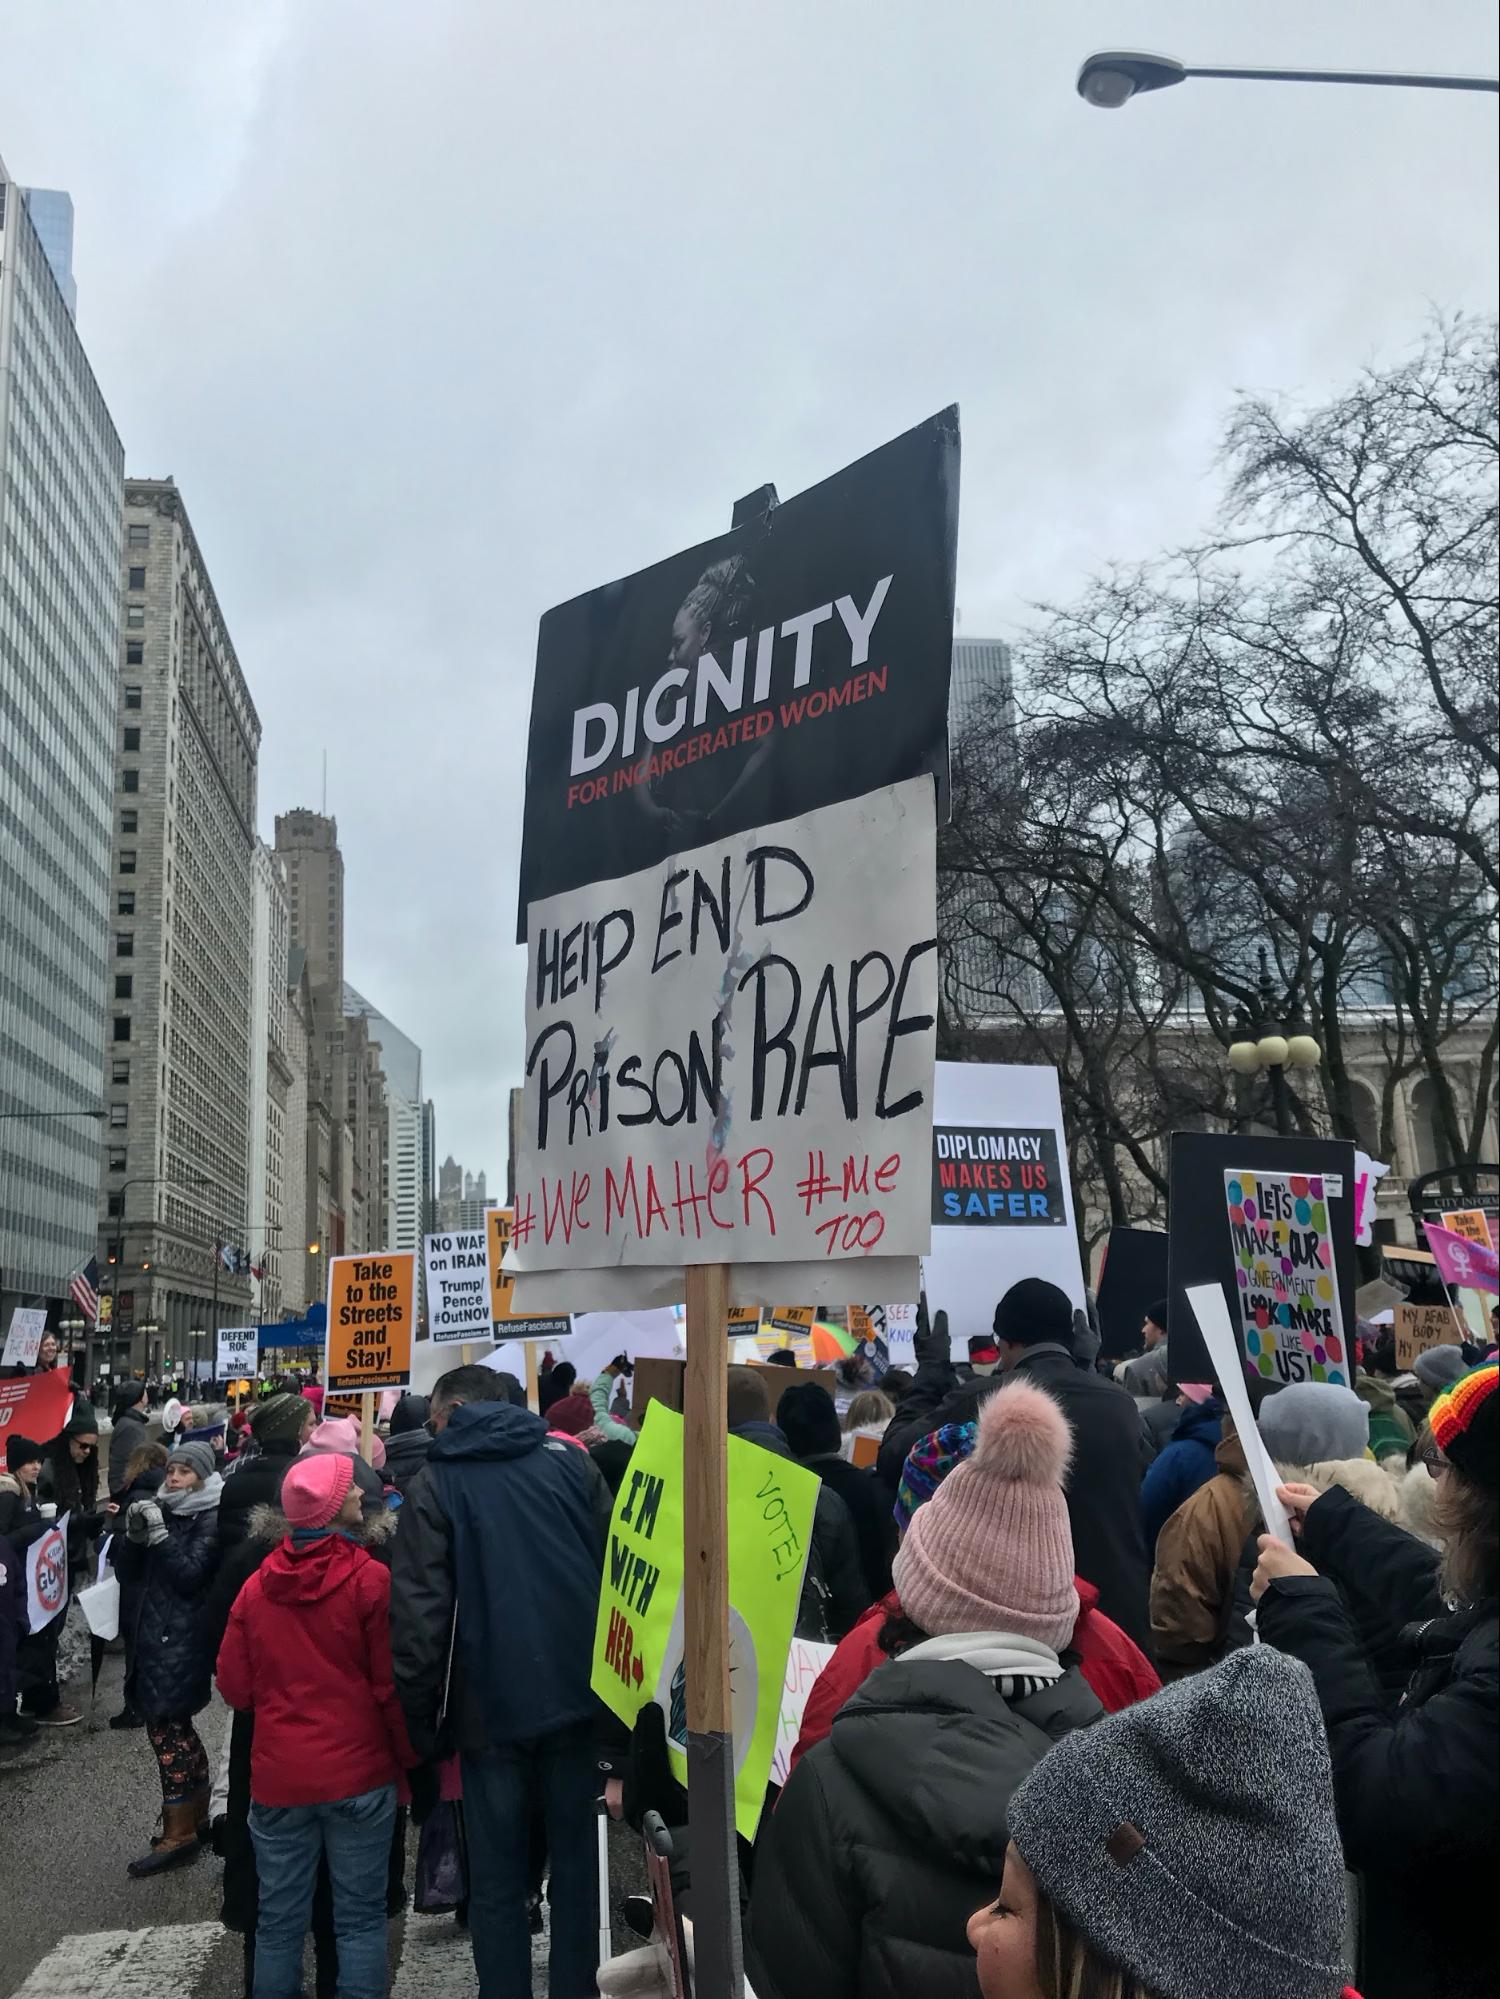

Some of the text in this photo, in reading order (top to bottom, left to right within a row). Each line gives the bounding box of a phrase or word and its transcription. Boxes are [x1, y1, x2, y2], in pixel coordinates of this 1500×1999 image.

[569, 574, 894, 777] DIGNITY
[567, 666, 888, 809] FOR INCARCERATED WOMEN
[651, 845, 815, 974] END
[738, 937, 937, 1121] RAPE
[936, 1134, 1041, 1160] DIPLOMACY
[796, 1150, 901, 1216] #Me
[940, 1163, 1048, 1190] MAKES US
[943, 1192, 1050, 1217] SAFER
[1434, 1198, 1458, 1208] CITY
[1454, 1215, 1475, 1226] Take
[815, 1210, 885, 1255] TOO
[430, 1238, 453, 1253] NO
[1232, 1223, 1325, 1270] MAKE OUR
[353, 1261, 393, 1281] Take
[430, 1253, 487, 1271] on IRAN
[346, 1281, 398, 1303] to the
[440, 1277, 485, 1294] Trump/
[1249, 1265, 1317, 1297] GOVERNMENT
[443, 1296, 484, 1308] Pence
[888, 1304, 909, 1321] SEE
[340, 1303, 403, 1326] Streets
[1242, 1292, 1334, 1337] LOOK MORE
[1402, 1309, 1418, 1324] MY
[221, 1331, 256, 1341] DEFEND
[353, 1325, 387, 1346] and
[498, 1320, 568, 1335] RefuseFascism.org
[889, 1328, 915, 1343] KNO
[1413, 1325, 1442, 1339] BODY
[229, 1341, 248, 1352] ROE
[1281, 1332, 1306, 1352] LIKE
[226, 1363, 249, 1371] WADE
[346, 1346, 392, 1371] Stay!
[1275, 1350, 1314, 1383] US!
[337, 1374, 401, 1387] RefuseFascism.org
[620, 1469, 664, 1540] I'M
[756, 1471, 803, 1582] VOTE!
[610, 1533, 660, 1618] WITH
[604, 1605, 635, 1690] HER
